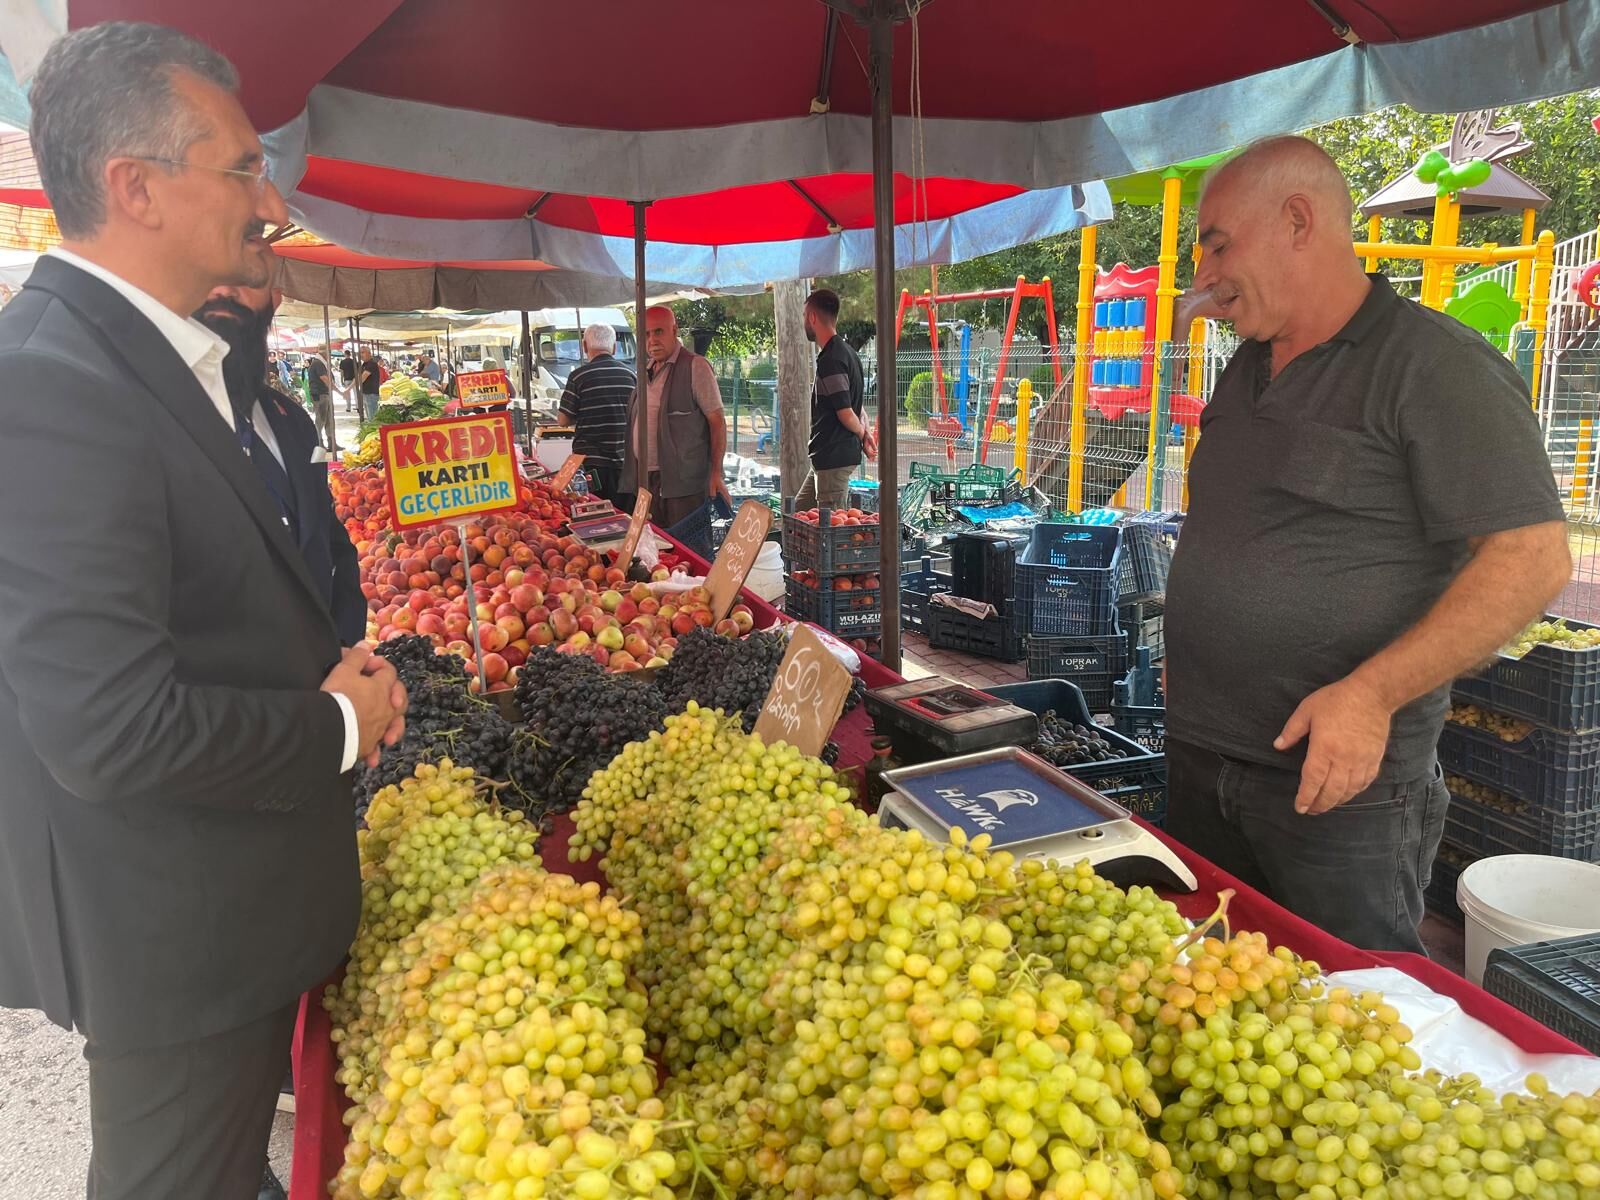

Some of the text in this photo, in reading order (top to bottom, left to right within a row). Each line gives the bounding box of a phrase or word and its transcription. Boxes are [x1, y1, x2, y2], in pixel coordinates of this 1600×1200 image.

[470, 386, 498, 394] KARTI
[393, 419, 508, 469] KREDİ
[418, 462, 489, 488] KARTI
[400, 481, 511, 515] GEÇERLİDİR
[784, 647, 820, 702] 60
[1061, 658, 1099, 666] TOPRAK
